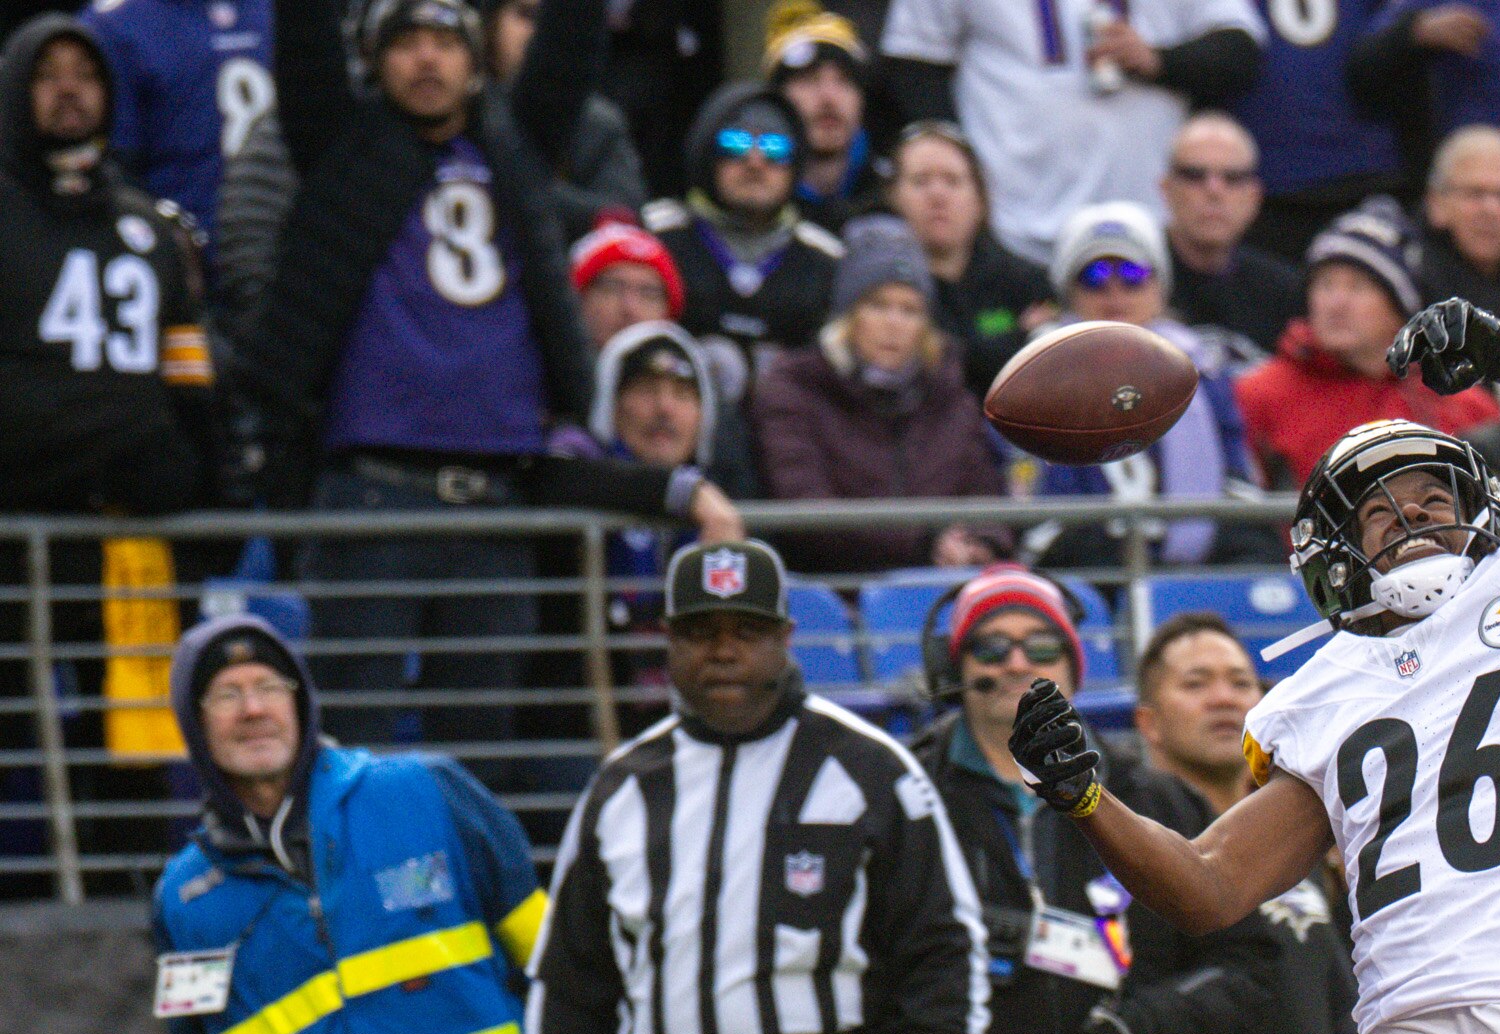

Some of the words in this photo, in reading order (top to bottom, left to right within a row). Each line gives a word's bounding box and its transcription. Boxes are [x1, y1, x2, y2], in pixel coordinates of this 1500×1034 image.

[422, 183, 505, 307] 8
[38, 248, 160, 374] 43
[1399, 658, 1419, 674] NFL
